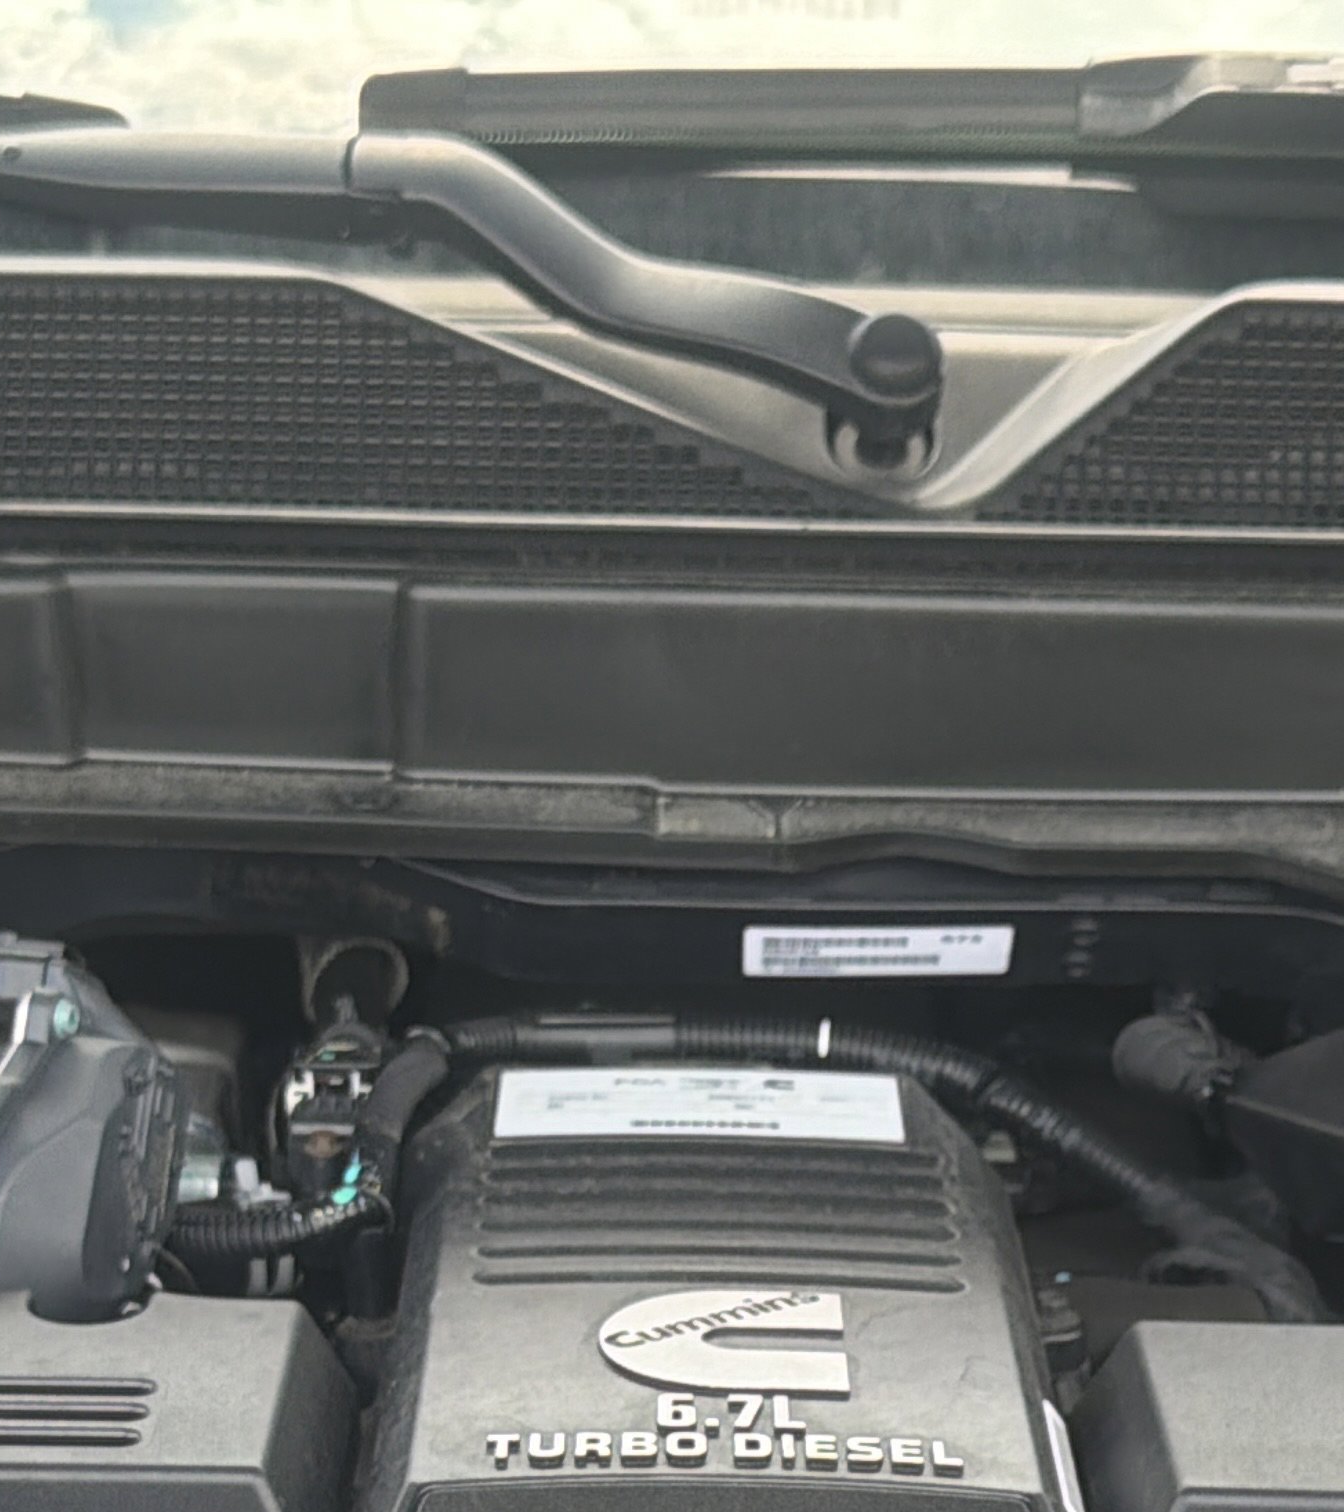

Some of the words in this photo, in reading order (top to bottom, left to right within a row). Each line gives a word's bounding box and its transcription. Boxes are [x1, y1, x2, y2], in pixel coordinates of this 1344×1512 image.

[604, 1290, 821, 1348] Cummins
[656, 1393, 807, 1435] 6.7L
[486, 1432, 709, 1469] TURBO
[732, 1432, 964, 1477] DIESEL
